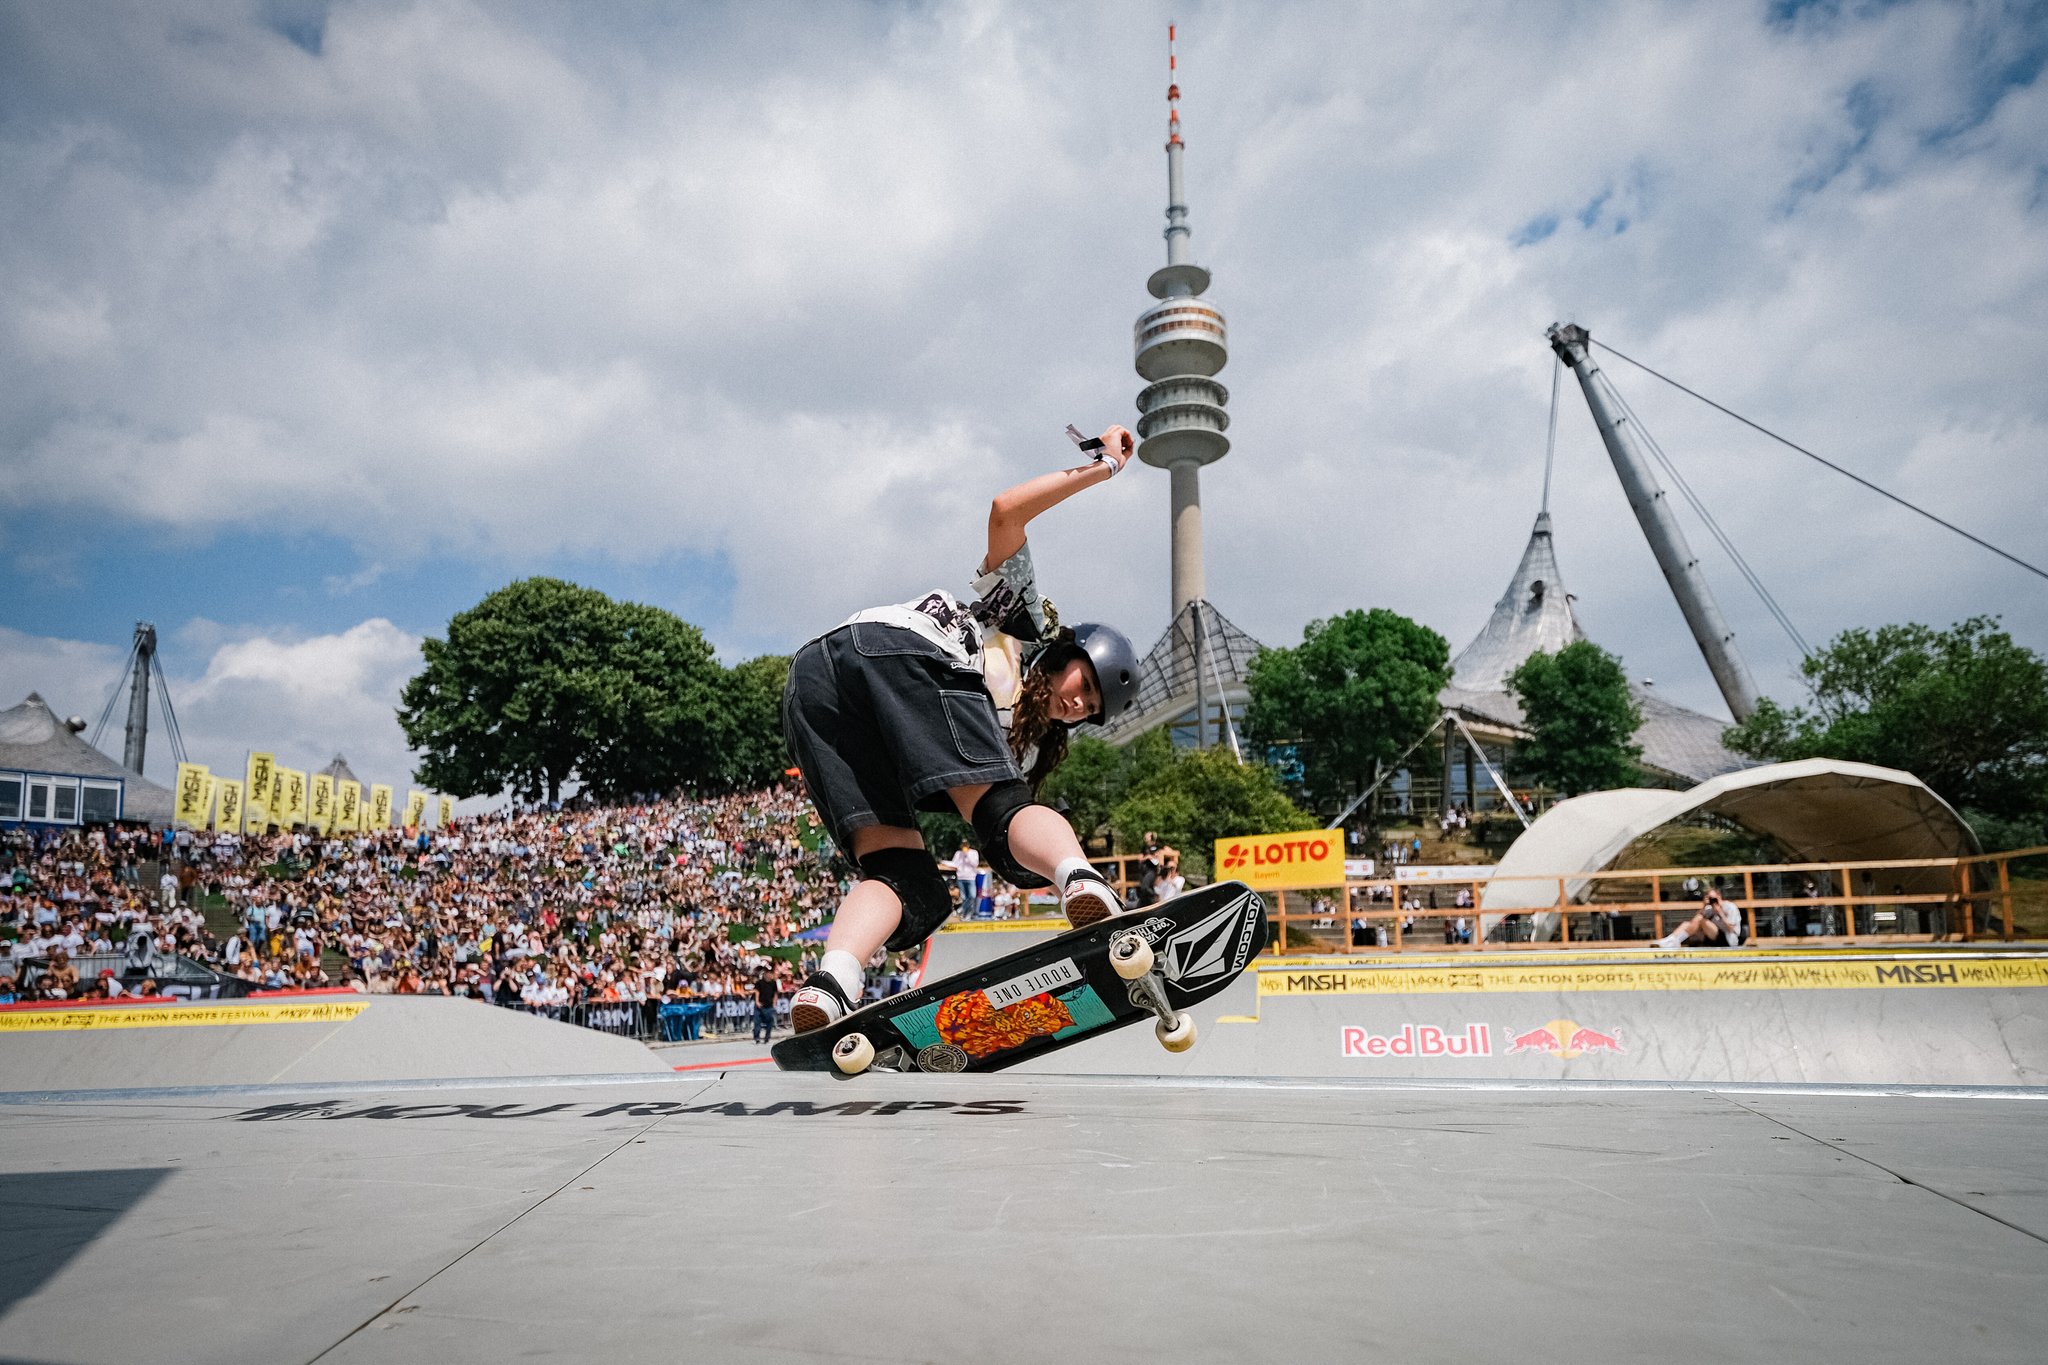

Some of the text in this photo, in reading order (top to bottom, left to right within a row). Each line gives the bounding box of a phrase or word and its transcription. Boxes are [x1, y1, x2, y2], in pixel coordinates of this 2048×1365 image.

[182, 769, 203, 813] MASH
[252, 758, 271, 801] MASH
[222, 784, 240, 823] MASH
[315, 781, 330, 816] MASH
[343, 786, 357, 821] MASH
[1254, 840, 1329, 865] LOTTO
[1232, 895, 1259, 968] VOLCOM
[992, 965, 1072, 1004] ROUTE ONE
[1287, 974, 1346, 991] MASH
[1487, 976, 1514, 985] THE
[1518, 974, 1572, 984] ACTION
[1576, 973, 1635, 984] SPORTS
[1639, 971, 1707, 983] FESTIVAL
[1876, 963, 1958, 983] MASH
[99, 1014, 121, 1024] THE
[123, 1013, 169, 1022] ACTION
[171, 1011, 218, 1021] SPORTS
[221, 1010, 270, 1020] FESTIVAL
[1344, 1025, 1489, 1055] Red Bull
[580, 1100, 1029, 1117] RAMPS
